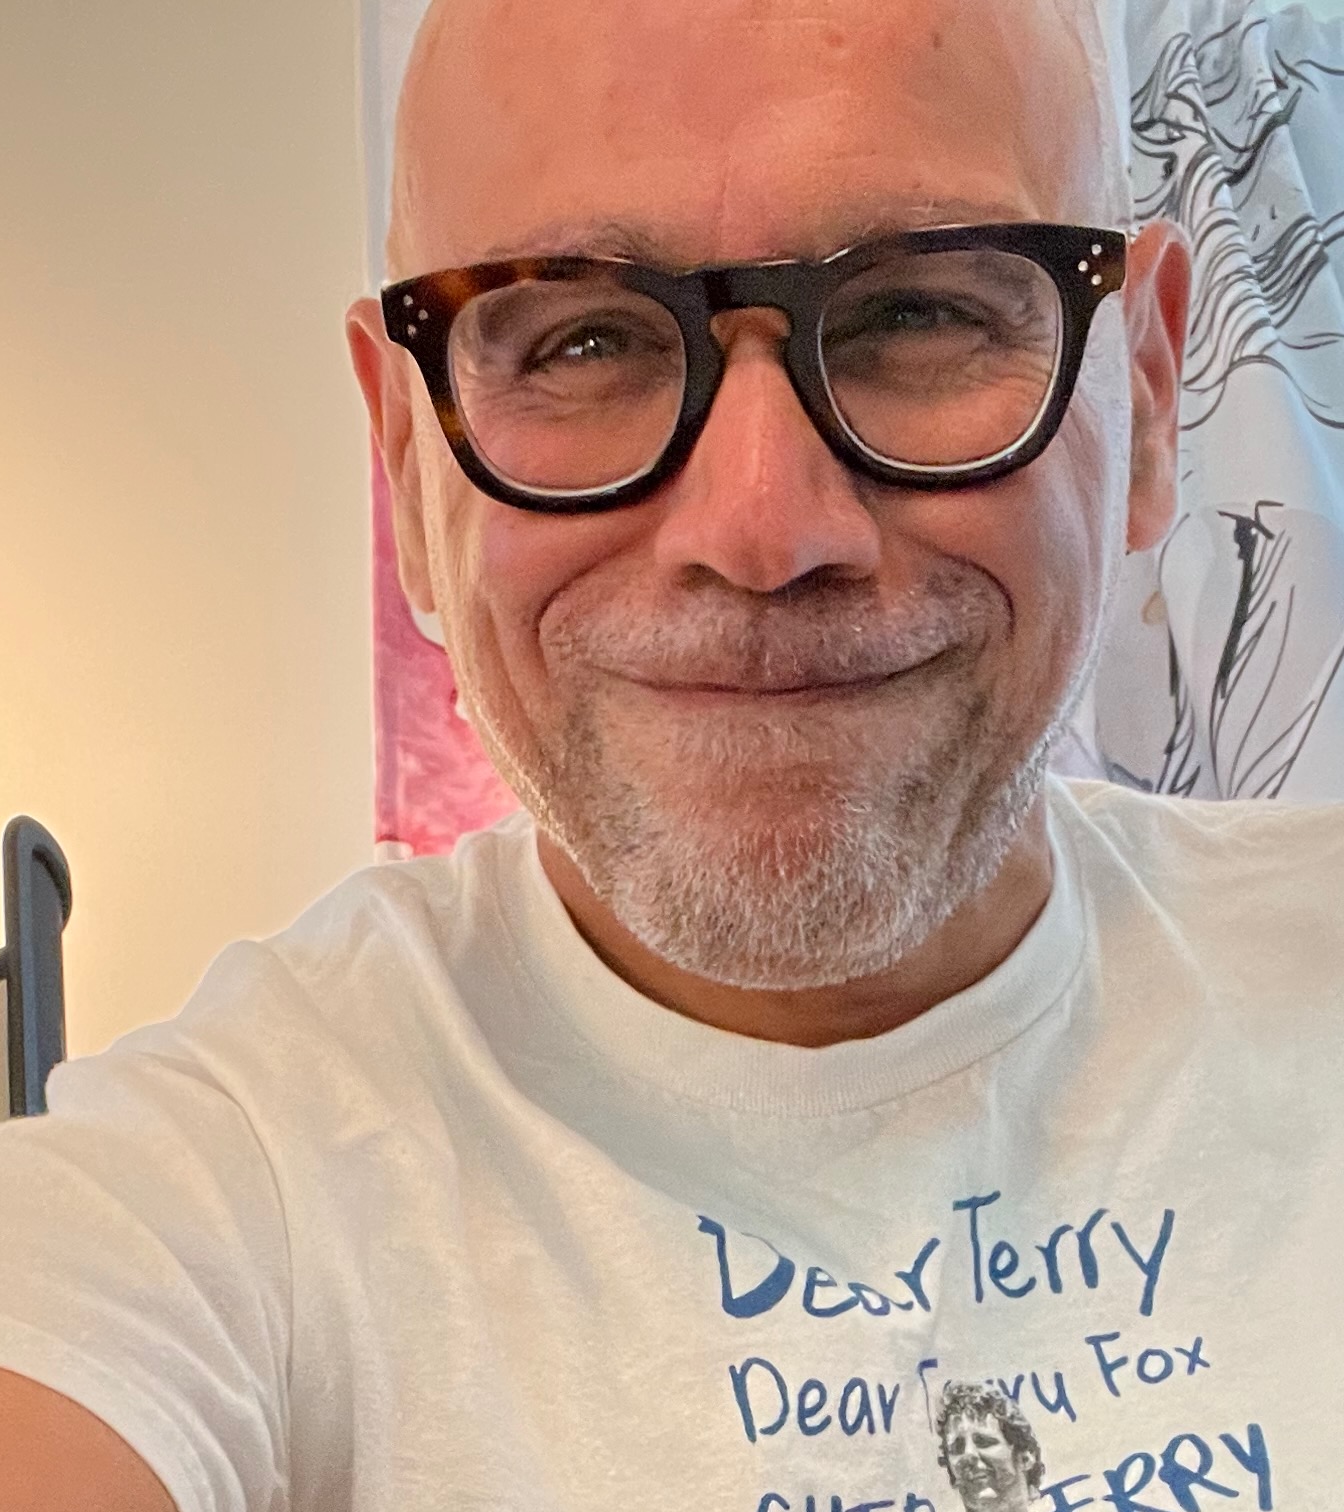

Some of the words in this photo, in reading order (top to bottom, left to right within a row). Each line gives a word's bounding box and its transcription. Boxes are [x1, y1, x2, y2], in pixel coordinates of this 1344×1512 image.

[696, 1215, 940, 1319] Dear
[952, 1190, 1175, 1316] Terry
[729, 1357, 900, 1442] Dear
[1084, 1331, 1211, 1398] Fox
